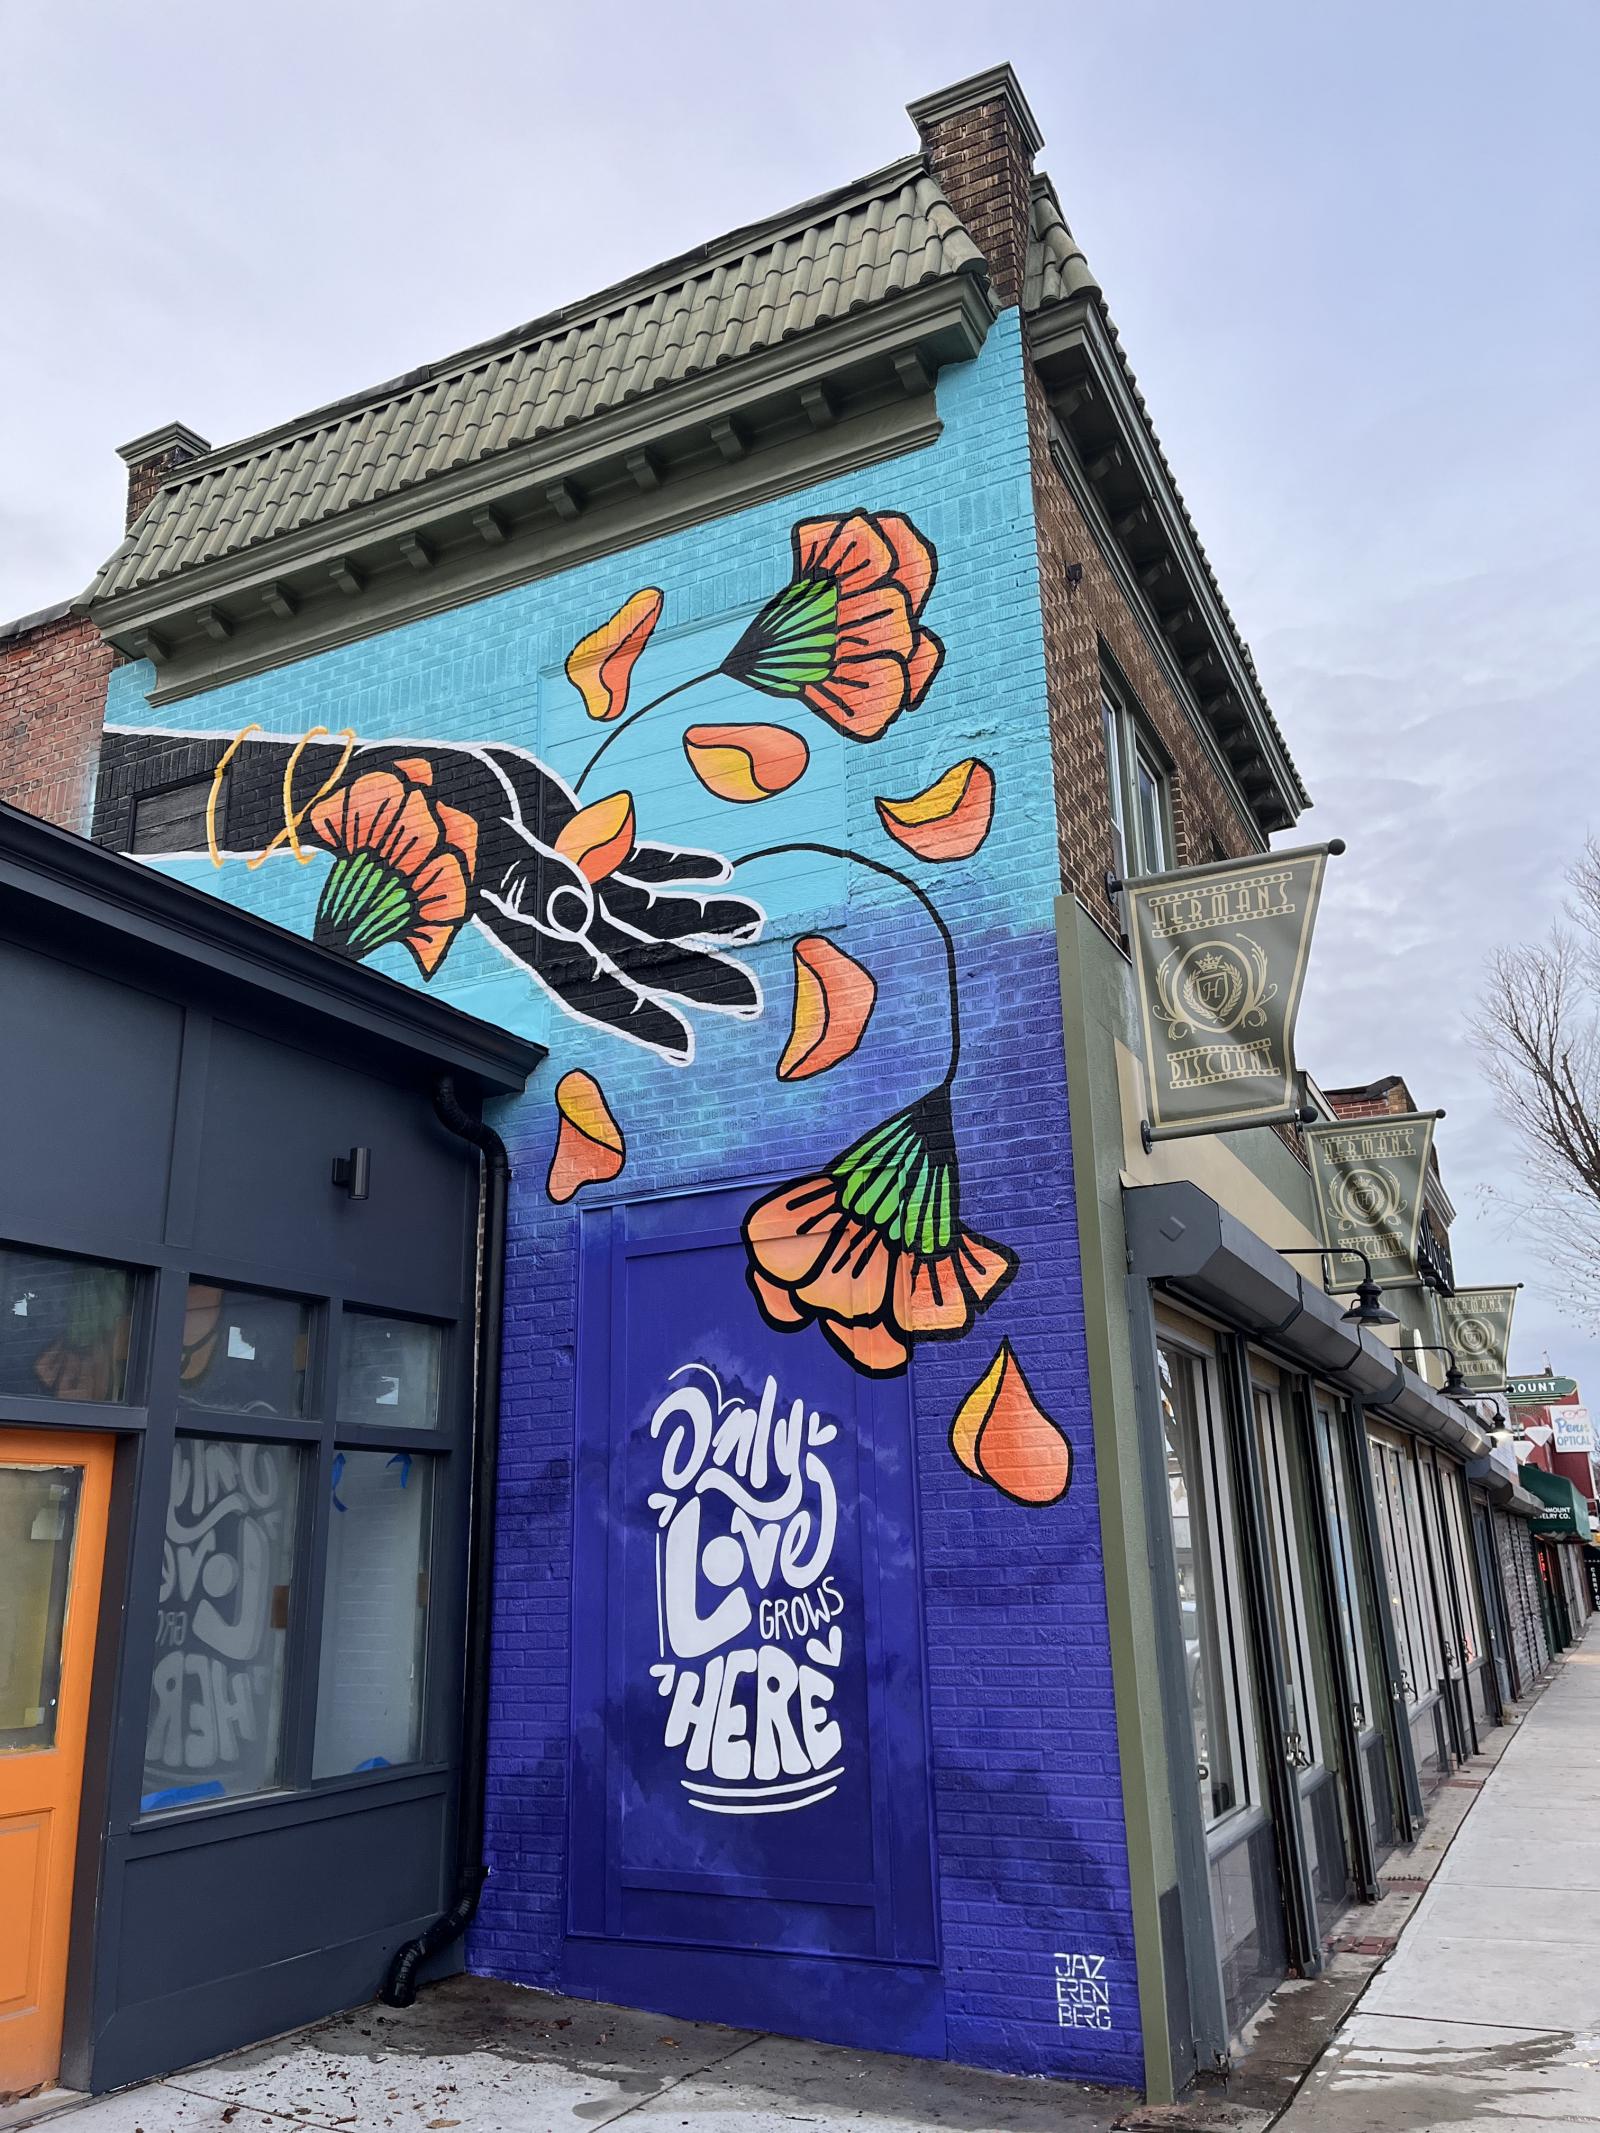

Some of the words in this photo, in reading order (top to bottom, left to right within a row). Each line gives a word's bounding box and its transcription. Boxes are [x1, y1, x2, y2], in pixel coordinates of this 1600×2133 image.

[1152, 881, 1288, 930] HERMANS
[1171, 1047, 1273, 1081] DISCOUNT
[1325, 1134, 1411, 1160] HERMANS
[651, 1374, 804, 1521] Only
[1557, 1435, 1591, 1446] OPTICAL
[665, 1452, 838, 1659] Love
[759, 1576, 845, 1640] GROWS
[664, 1644, 842, 1781] HERE
[1054, 1952, 1107, 1980] JAZ
[1058, 2003, 1111, 2030] BERG
